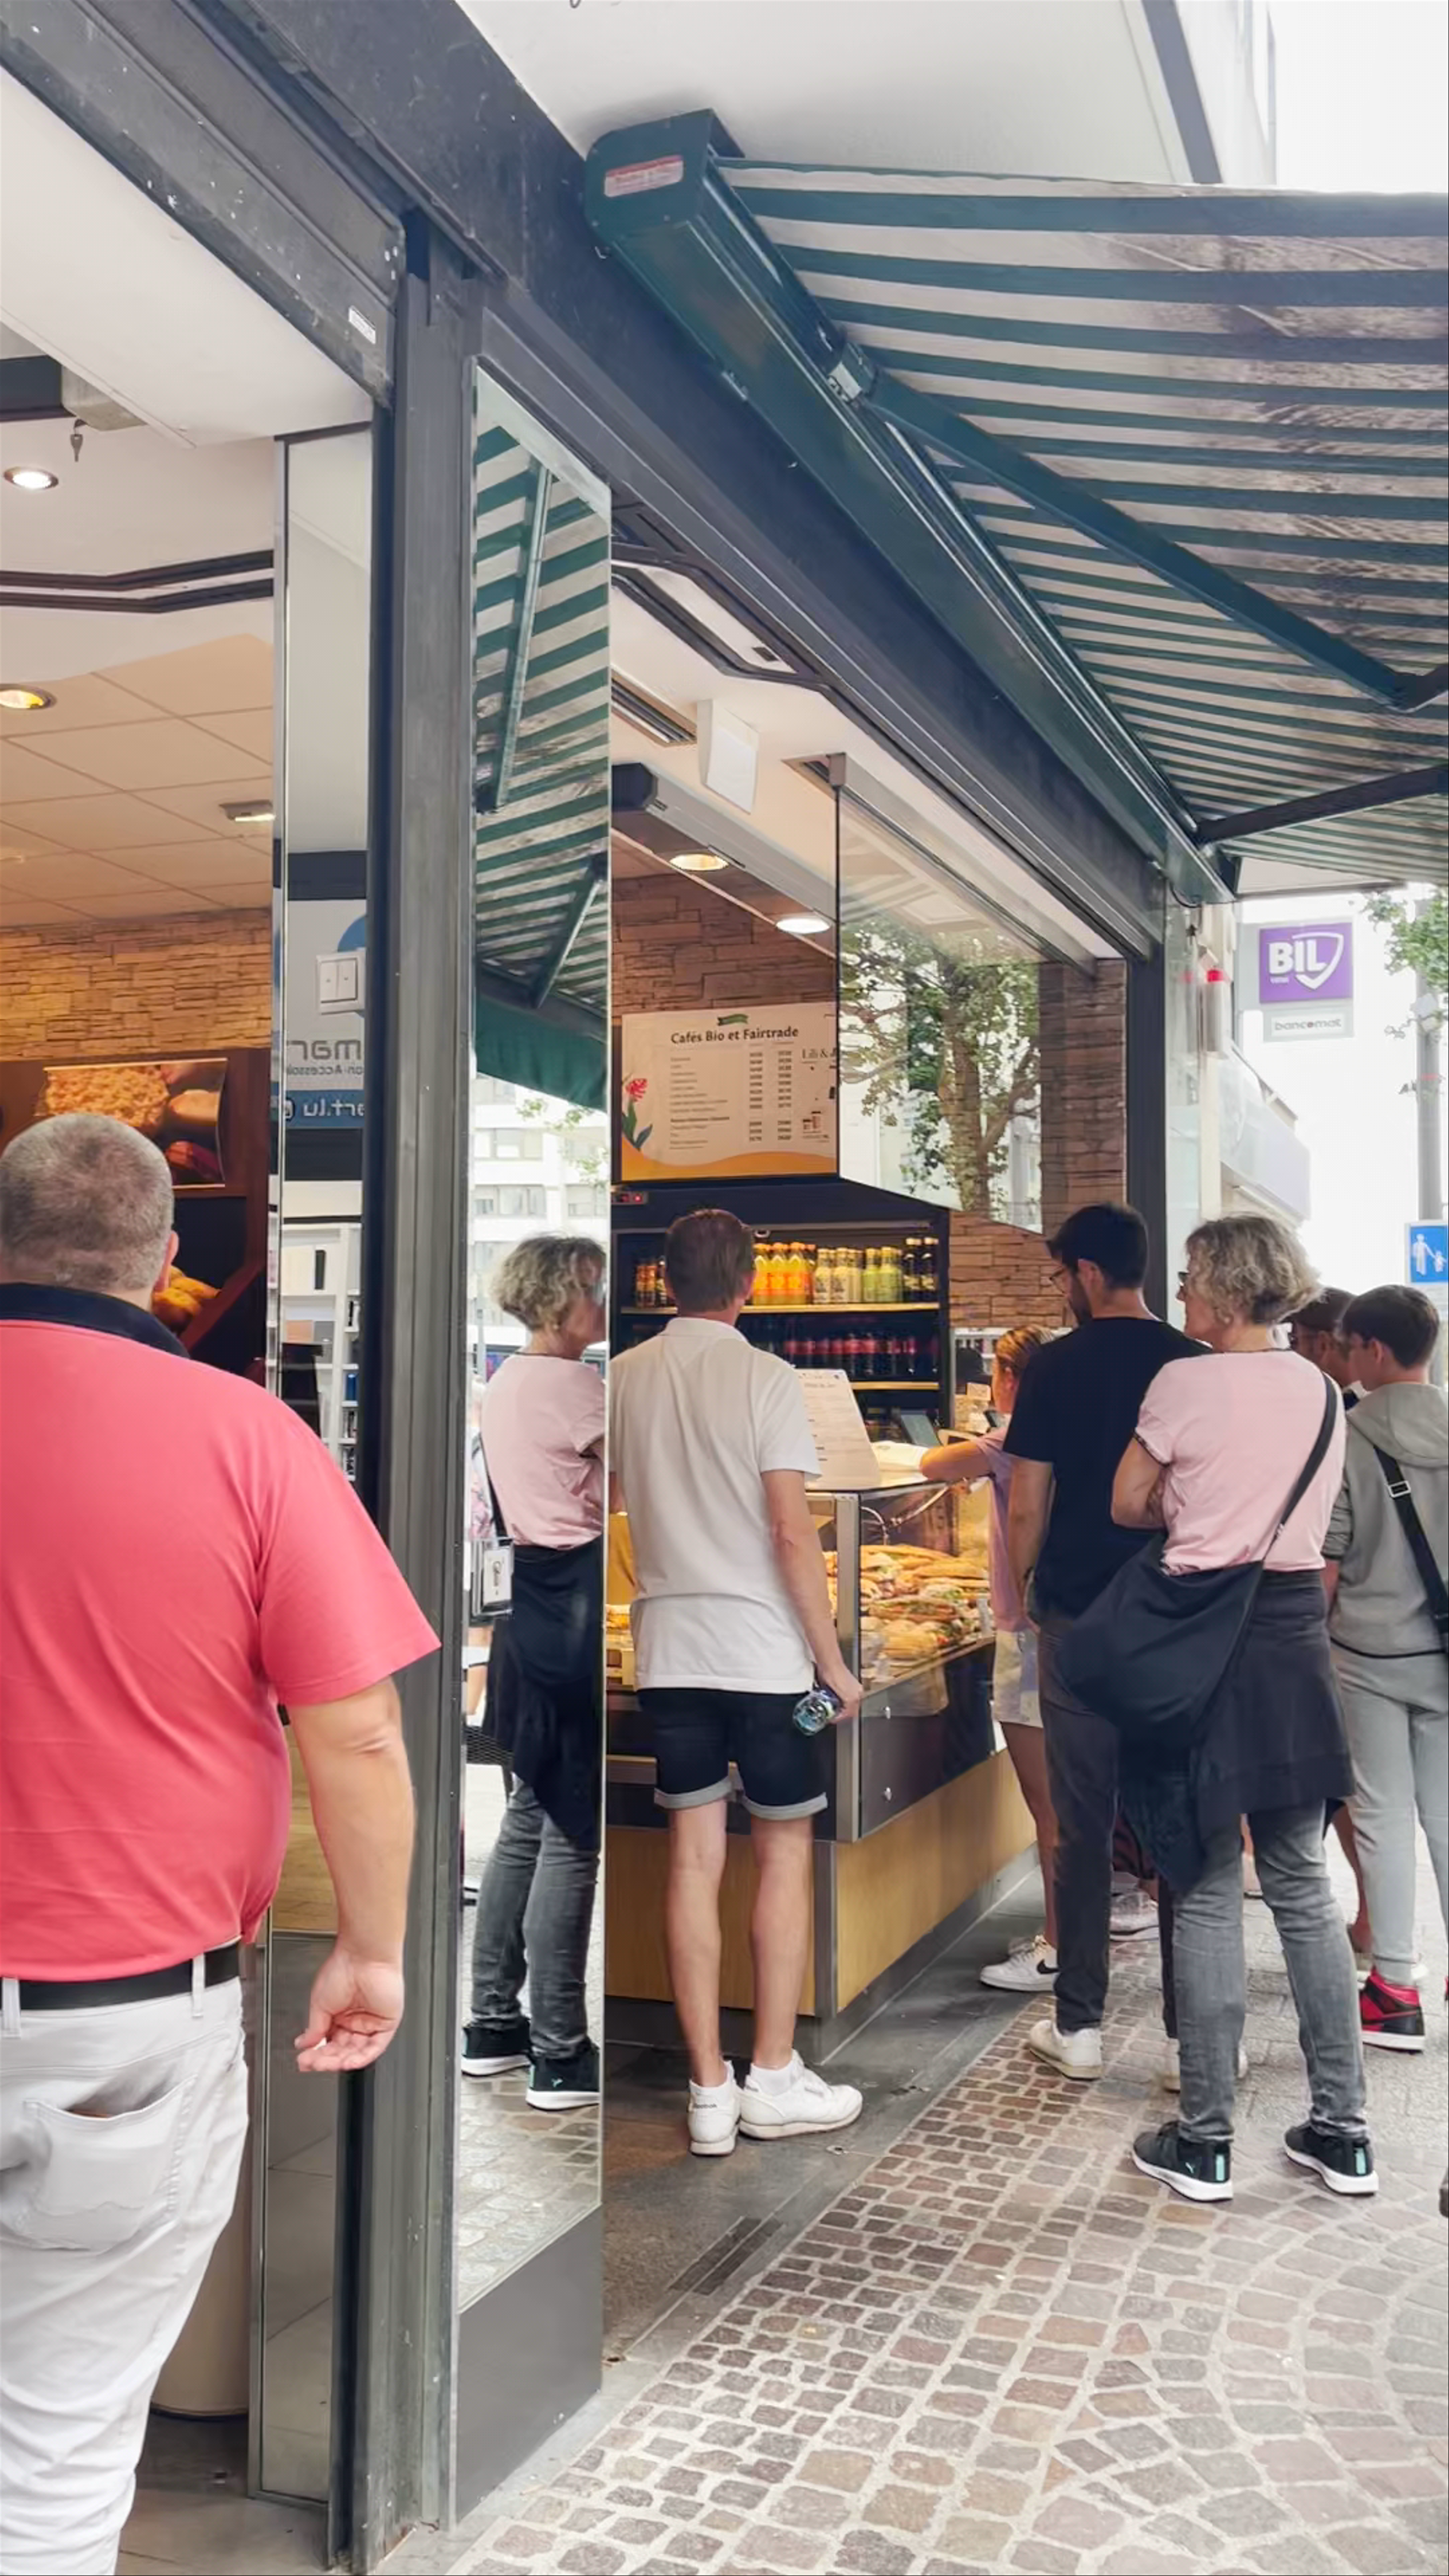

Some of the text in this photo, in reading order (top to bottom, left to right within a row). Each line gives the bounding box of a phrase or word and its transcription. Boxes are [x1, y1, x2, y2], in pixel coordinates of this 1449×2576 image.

[1269, 939, 1328, 974] BIL
[706, 1030, 724, 1041] Bio
[728, 1030, 739, 1040] et
[743, 1026, 798, 1039] Fairtrade
